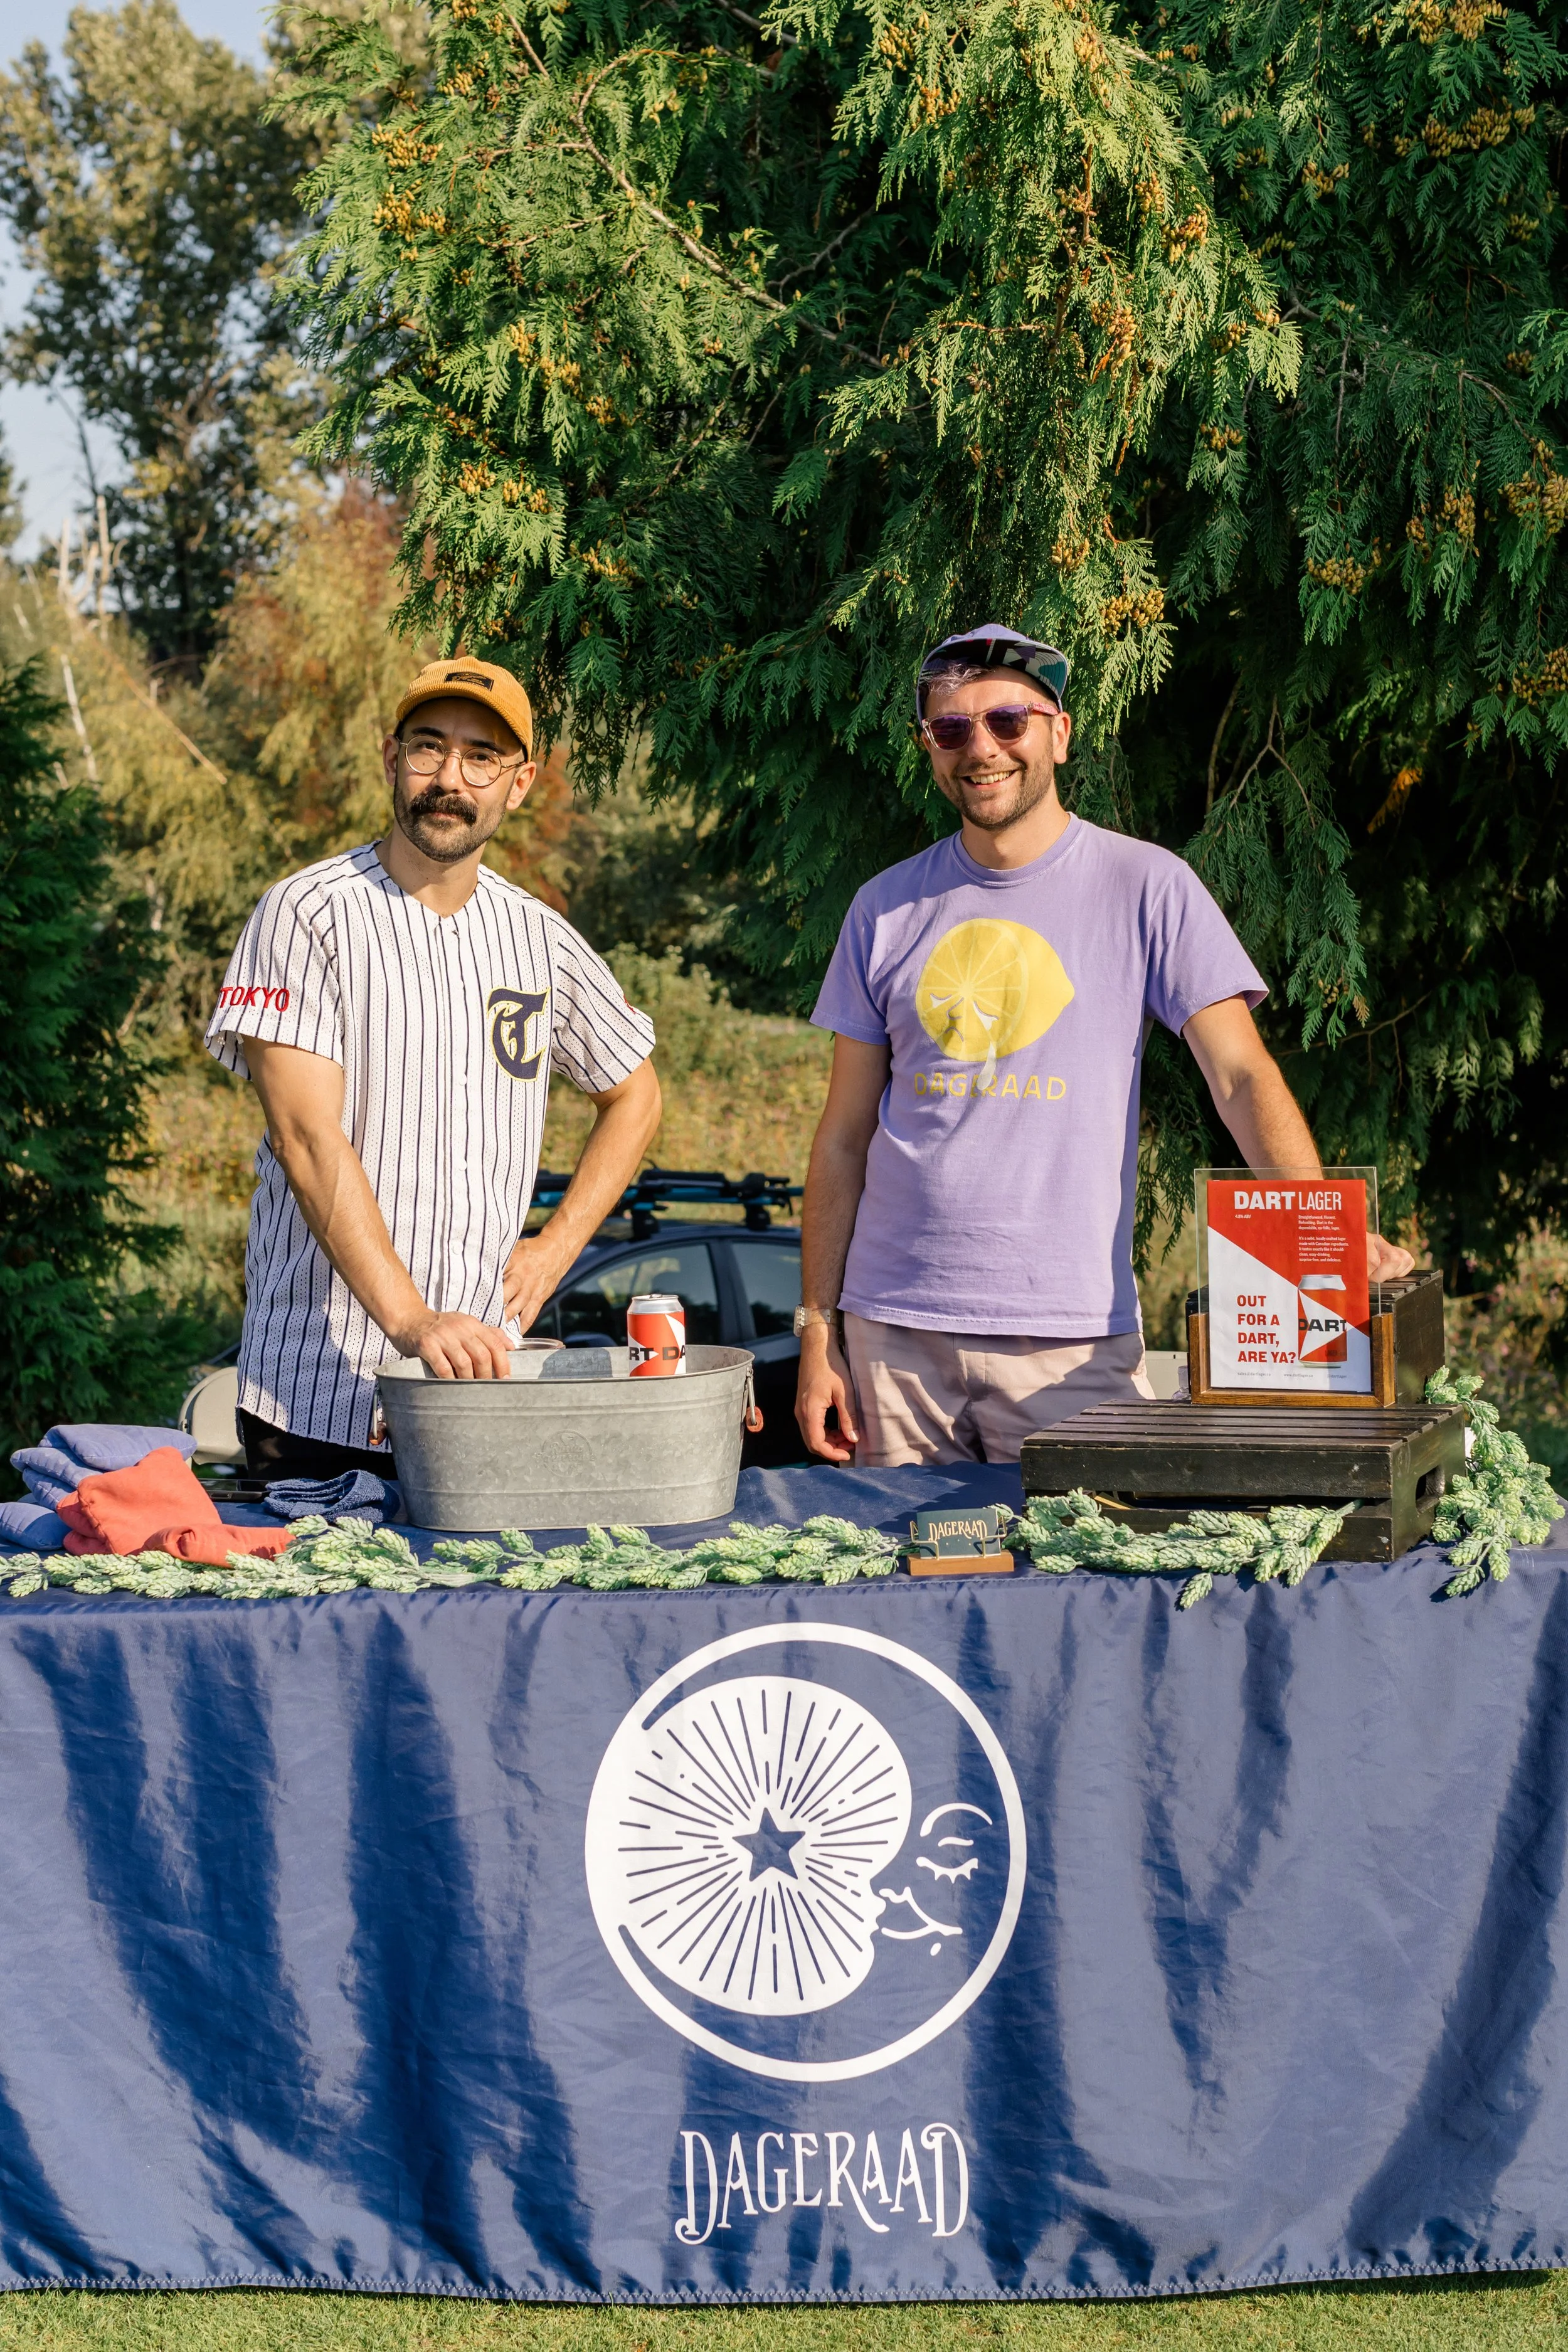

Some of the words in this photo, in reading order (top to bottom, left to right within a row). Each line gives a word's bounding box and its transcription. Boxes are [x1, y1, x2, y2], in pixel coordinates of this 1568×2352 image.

[220, 987, 290, 1012] TOKYO
[914, 1072, 1067, 1100] DAGERAAD
[1234, 1191, 1296, 1210] DART
[1298, 1192, 1342, 1210] LAGER
[1237, 1295, 1266, 1307] OUT
[1237, 1313, 1266, 1325] FOR
[1270, 1314, 1280, 1325] A
[1298, 1318, 1347, 1332] DART
[1237, 1332, 1279, 1348] DART,
[1237, 1350, 1268, 1362] ARE
[1270, 1352, 1296, 1364] YA?
[928, 1519, 987, 1542] DAGERAAD
[675, 2122, 969, 2245] DAGERAAD
